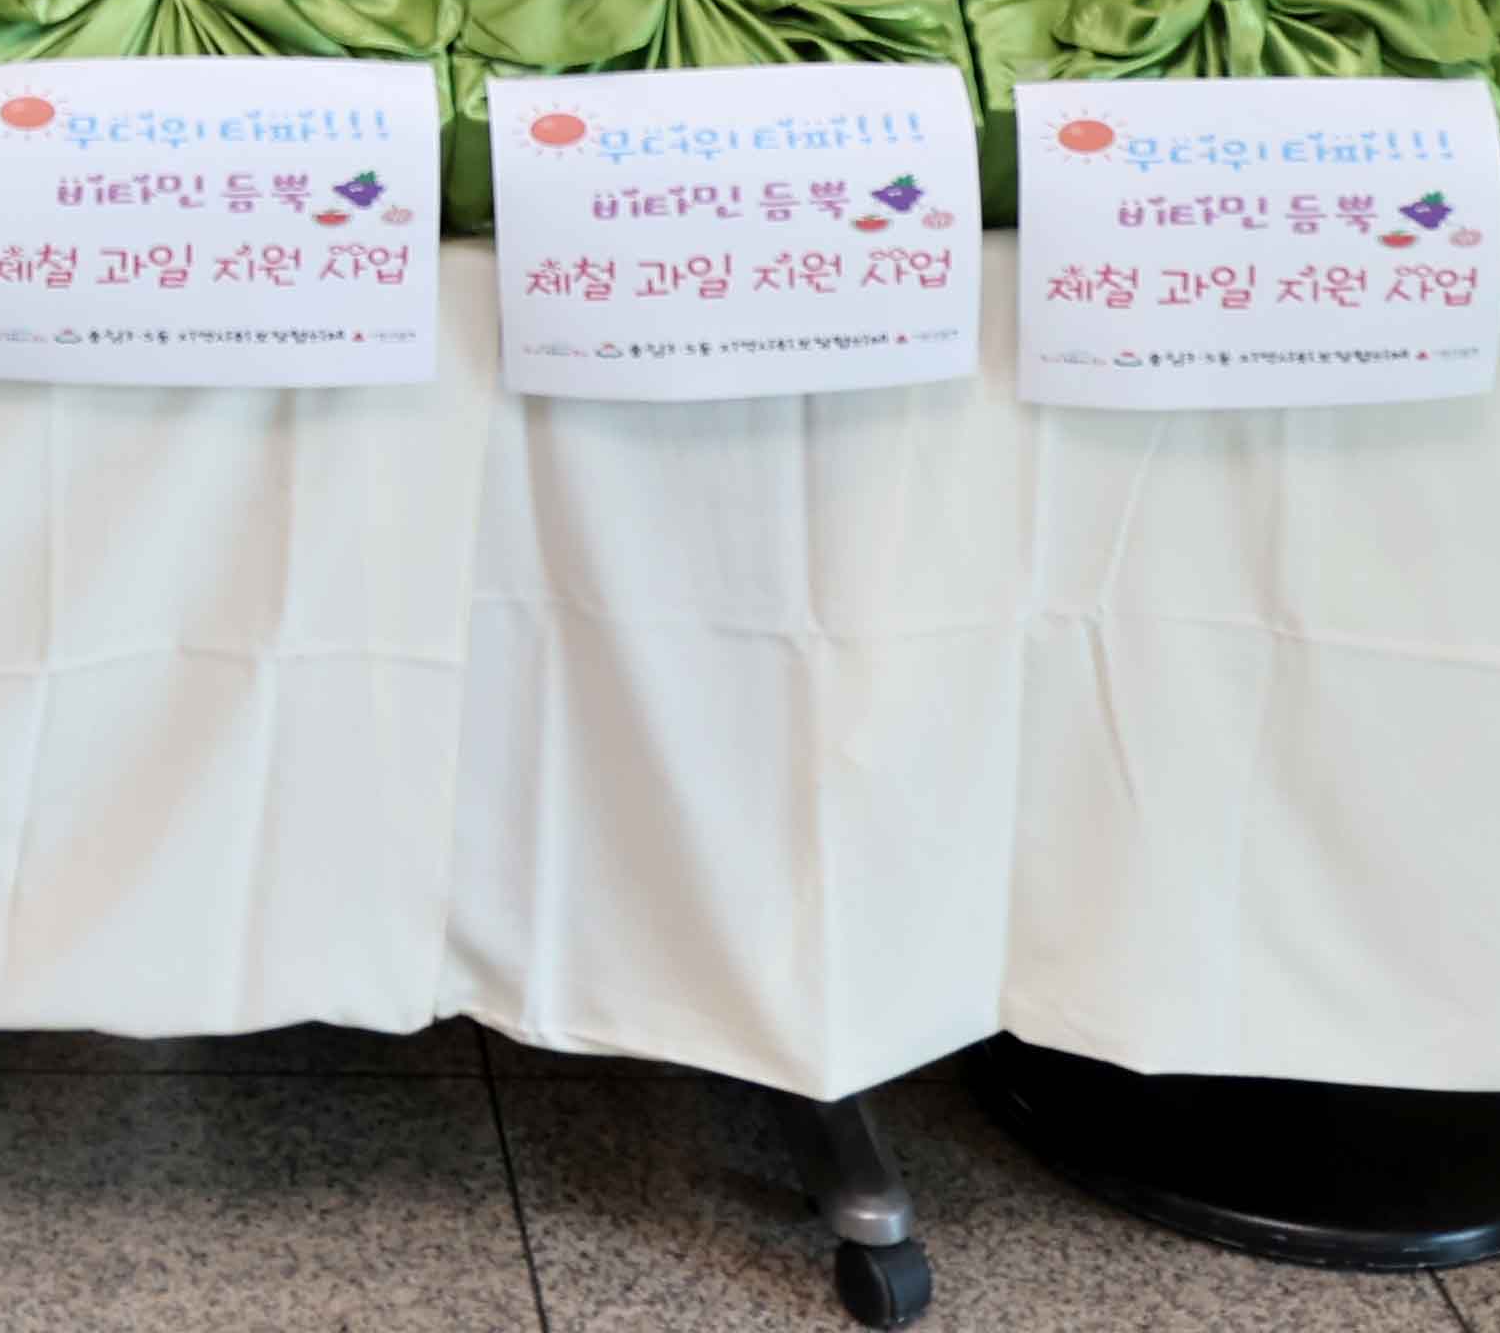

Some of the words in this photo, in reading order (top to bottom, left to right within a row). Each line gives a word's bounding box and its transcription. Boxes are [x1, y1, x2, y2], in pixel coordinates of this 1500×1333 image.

[64, 110, 205, 151] 무더위
[218, 110, 393, 142] 타파!!!
[597, 124, 739, 164] 무더위
[751, 112, 926, 150] 타파!!!
[1124, 133, 1268, 173] 무더위
[1281, 129, 1455, 165] 타파!!!
[56, 173, 206, 210] 비타민
[591, 184, 745, 219] 비타민
[1116, 195, 1270, 229] 비타민
[95, 243, 195, 290] 과일
[211, 243, 303, 288] 지원
[318, 243, 410, 287] 사업
[524, 256, 617, 302] 제철
[634, 253, 734, 301] 과일
[751, 250, 843, 294] 지원
[859, 247, 953, 290] 사업
[1046, 263, 1139, 311] 제철
[1158, 264, 1258, 310] 과일
[1276, 264, 1368, 307] 지원
[1384, 263, 1479, 306] 사업
